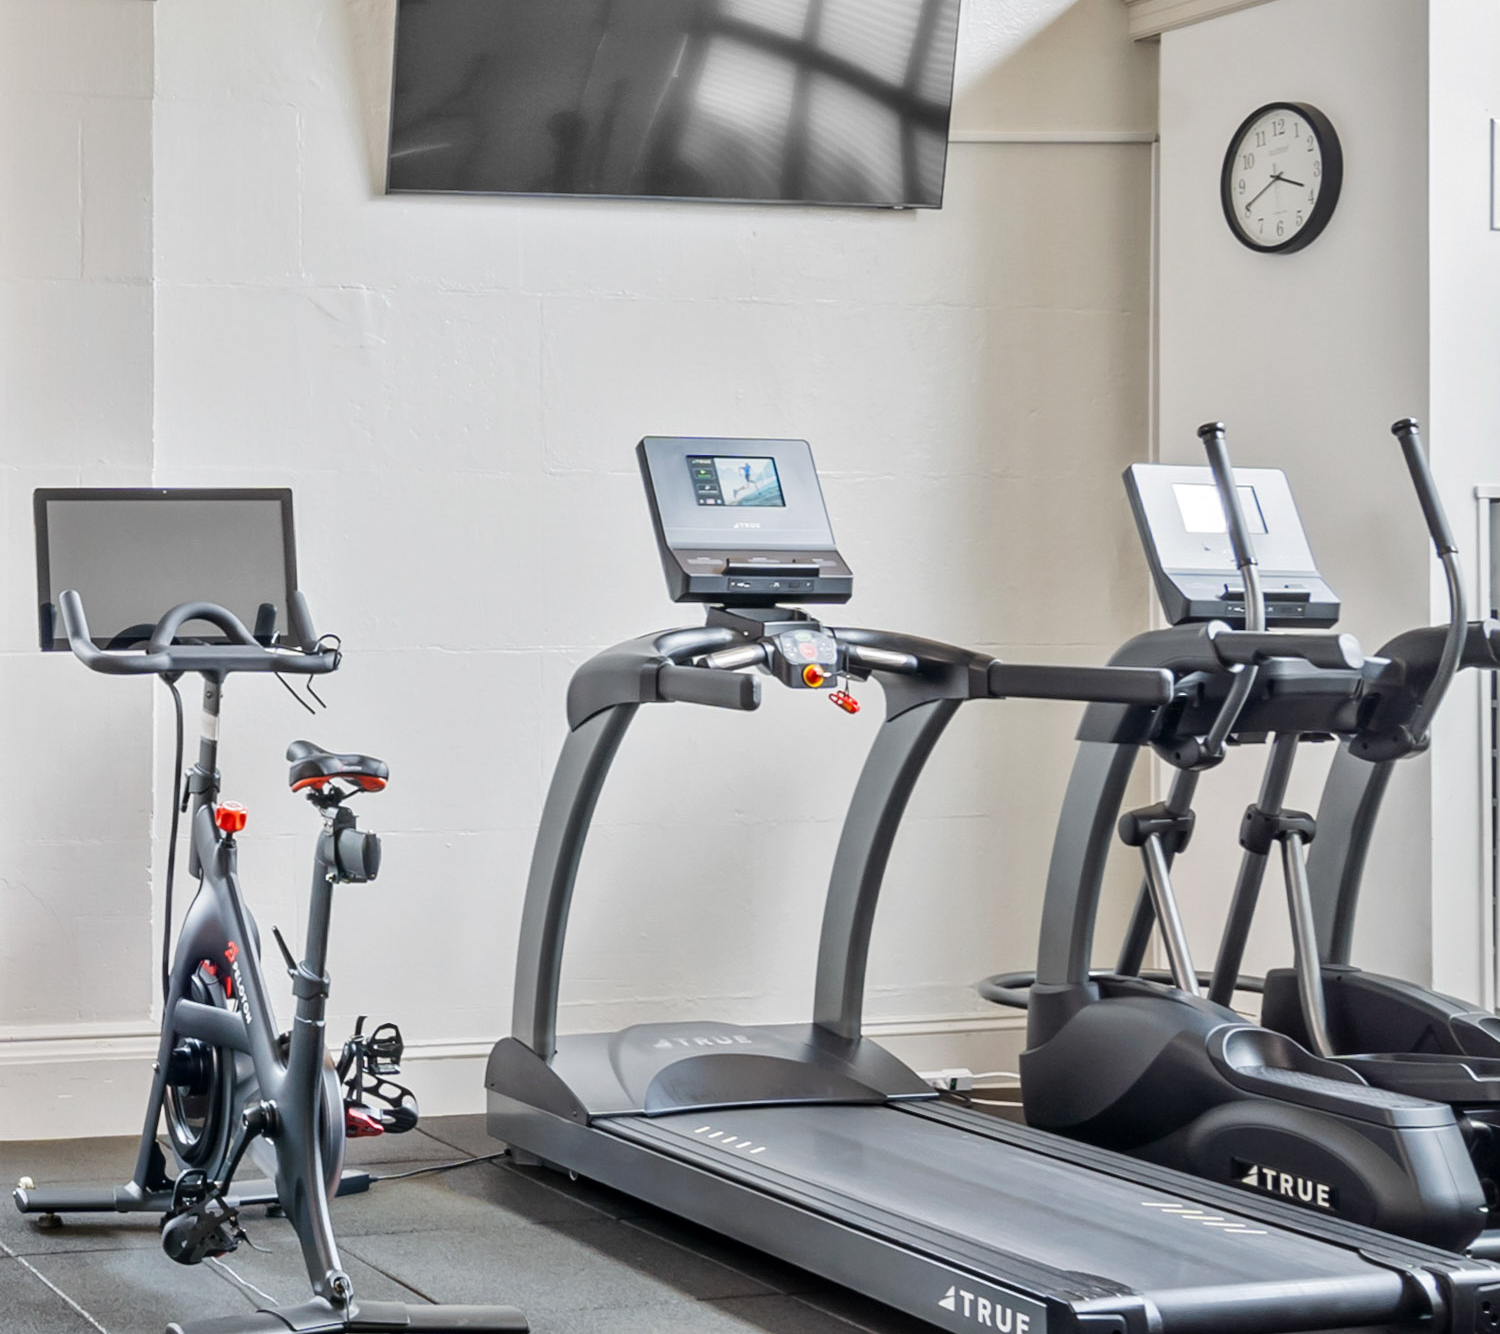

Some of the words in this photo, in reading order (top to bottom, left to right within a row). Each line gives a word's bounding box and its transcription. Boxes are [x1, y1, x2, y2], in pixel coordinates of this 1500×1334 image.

[1272, 119, 1285, 137] 12
[1294, 122, 1300, 138] 1
[1256, 131, 1266, 147] 11
[1307, 135, 1314, 152] 2
[1243, 153, 1255, 170] 10
[1313, 160, 1320, 177] 3
[1238, 179, 1246, 195] 9
[1307, 188, 1314, 205] 4
[1258, 218, 1264, 234] 7
[1295, 210, 1303, 226] 5
[1276, 220, 1284, 236] 6
[232, 961, 252, 1024] PELOTON
[1262, 1168, 1330, 1207] TRUE
